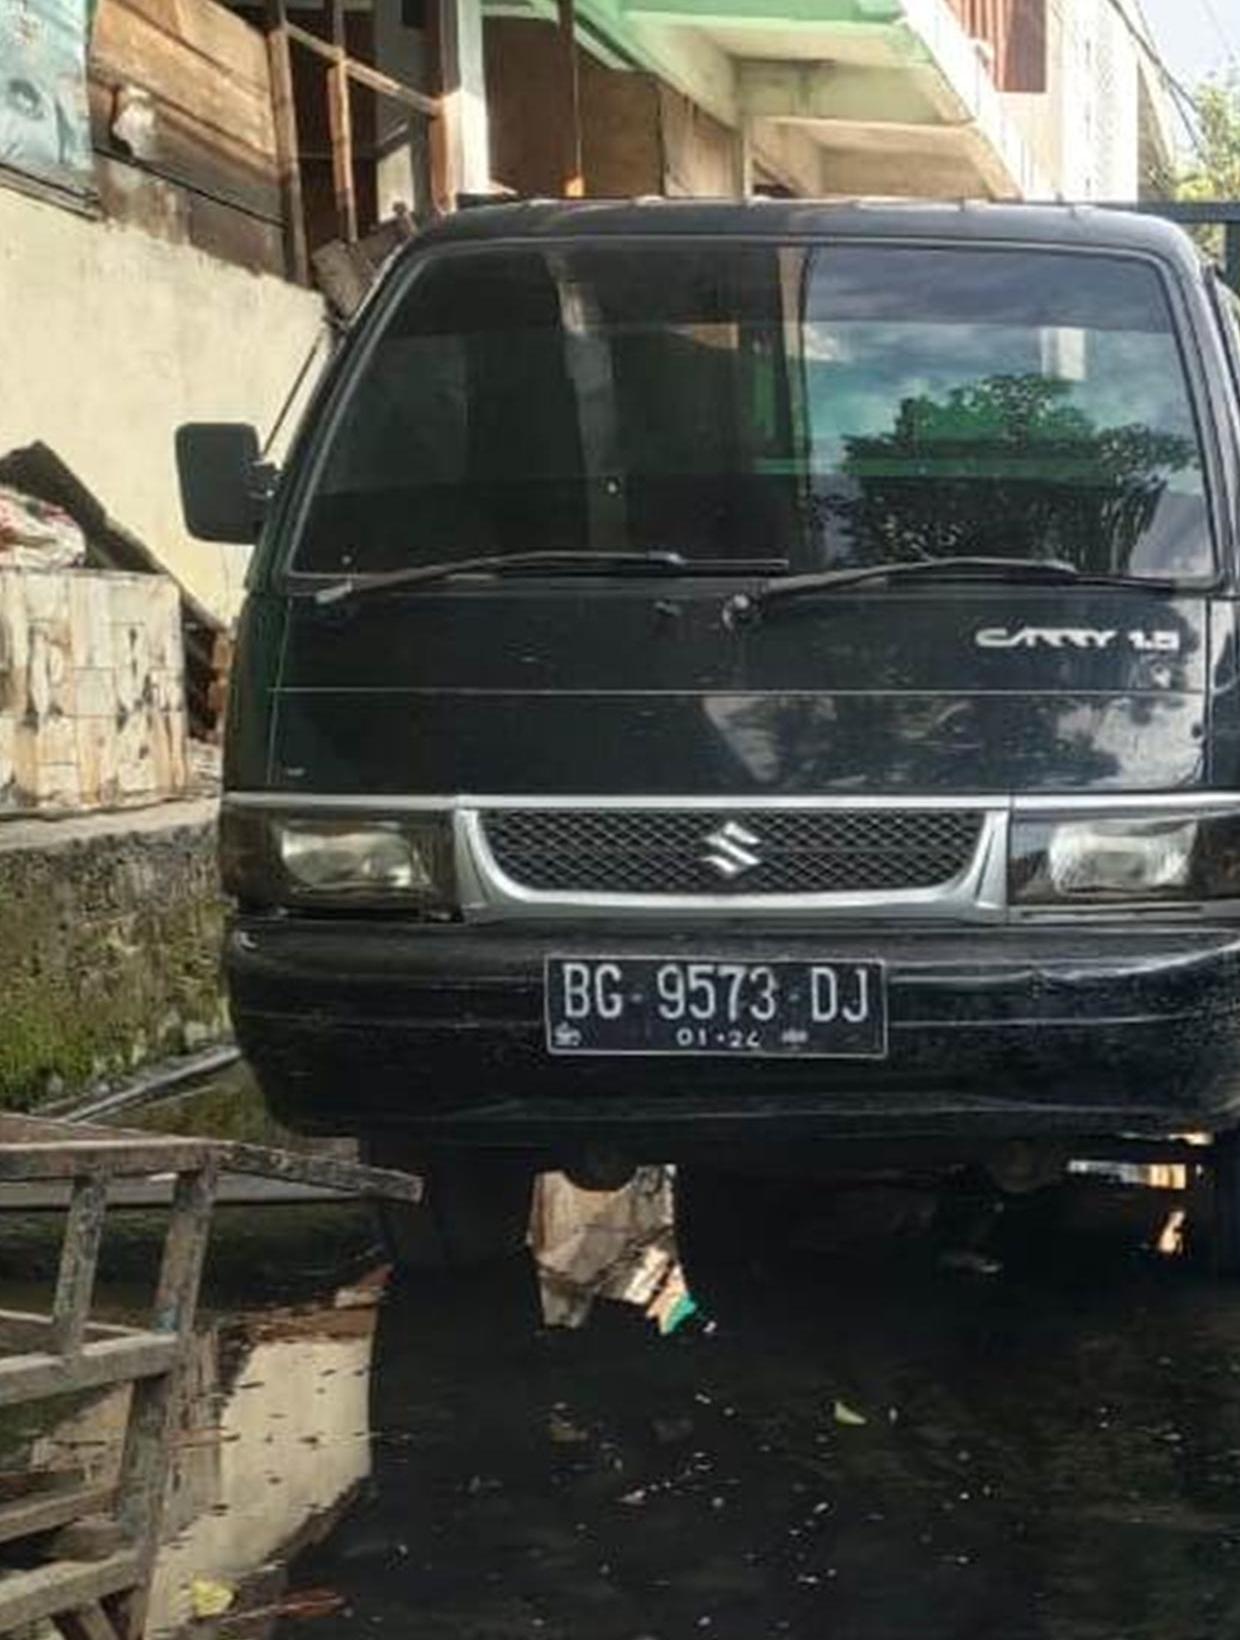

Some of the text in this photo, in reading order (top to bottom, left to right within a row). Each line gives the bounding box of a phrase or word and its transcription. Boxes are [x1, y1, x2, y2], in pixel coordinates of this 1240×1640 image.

[975, 627, 1116, 648] CARRY
[563, 963, 869, 1022] BG 9573 DJ
